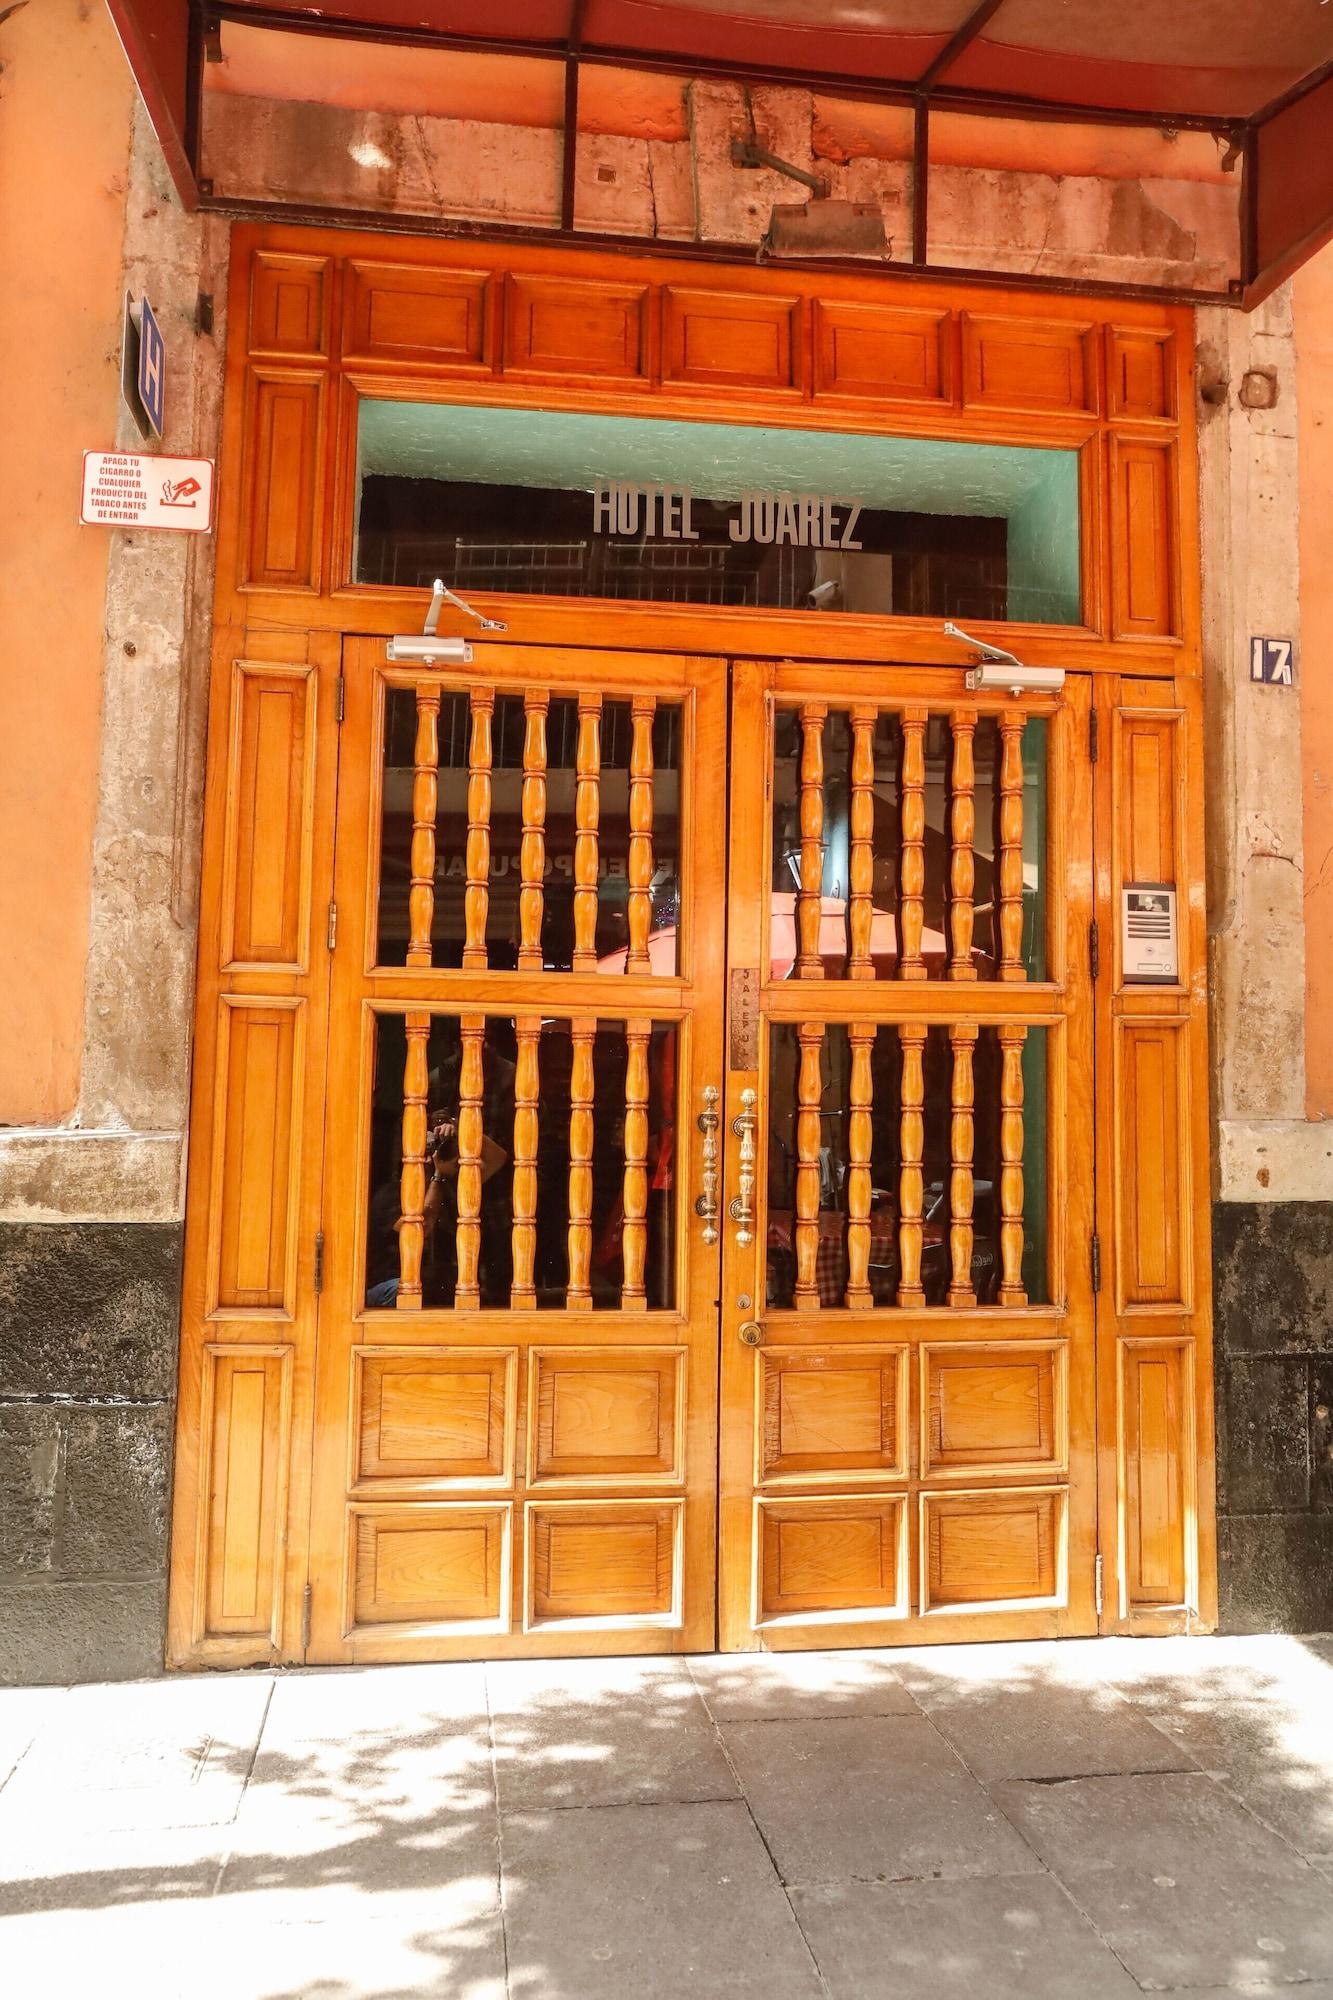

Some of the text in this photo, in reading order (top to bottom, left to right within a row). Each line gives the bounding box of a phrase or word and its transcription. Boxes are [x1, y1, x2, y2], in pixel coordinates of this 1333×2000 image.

[103, 457, 127, 465] APAGA
[100, 467, 134, 476] CIGARRO
[98, 478, 140, 487] CUALQUIER
[91, 488, 147, 499] PRODUCTO DEL
[91, 499, 147, 510] TABACO ANTES
[98, 510, 138, 519] DE ENTRAR
[593, 480, 863, 549] HOTEL JUAREZ
